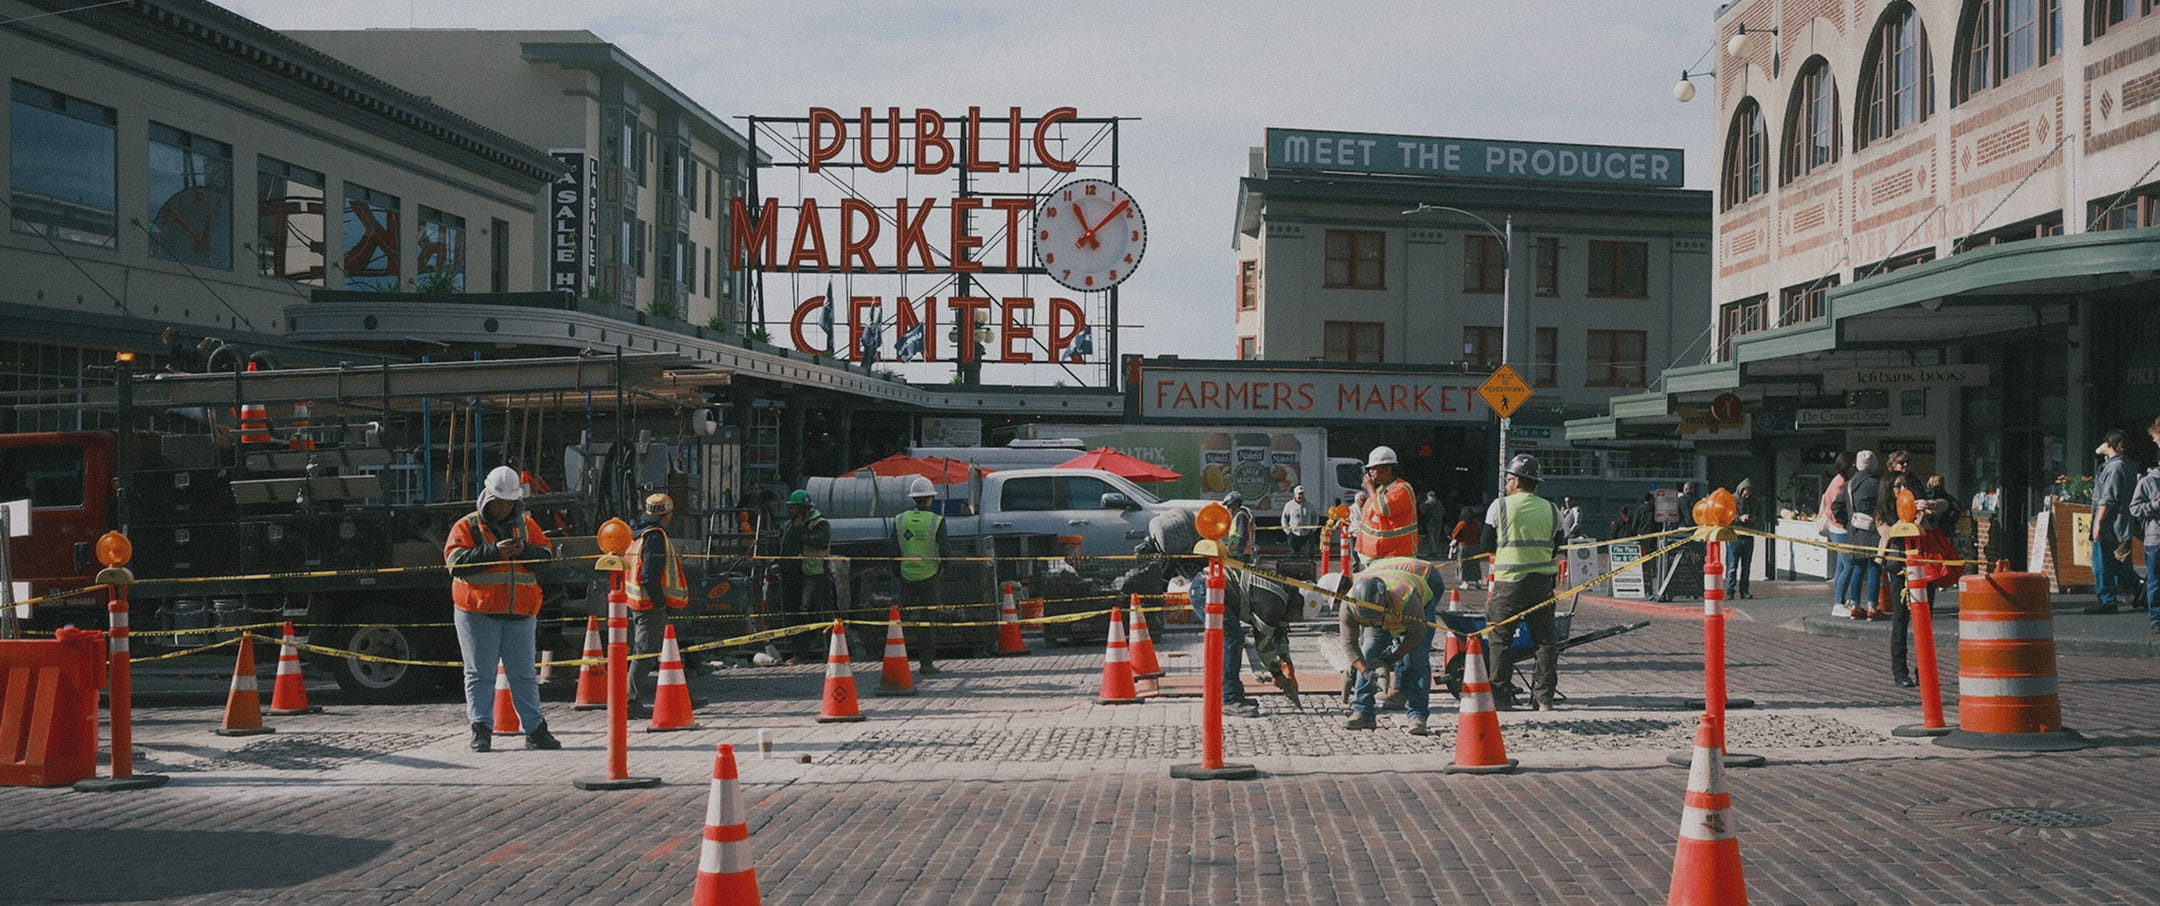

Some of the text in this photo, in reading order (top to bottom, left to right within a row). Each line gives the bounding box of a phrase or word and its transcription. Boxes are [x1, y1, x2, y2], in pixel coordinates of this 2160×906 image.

[808, 106, 1077, 175] PUBLIC
[1284, 135, 1670, 181] MEET THE PRODUCER
[590, 160, 597, 189] LA
[1085, 184, 1096, 195] 12
[1063, 191, 1072, 201] 11
[1111, 191, 1115, 202] 1
[1046, 207, 1057, 218] 10
[1126, 208, 1134, 218] 2
[555, 190, 577, 263] SALLE
[728, 197, 1035, 273] MARKET
[1040, 230, 1049, 240] 9
[1131, 230, 1139, 242] 3
[1046, 253, 1054, 264] 8
[1123, 253, 1133, 264] 4
[1062, 269, 1071, 280] 7
[1109, 269, 1117, 280] 5
[1084, 275, 1093, 286] 6
[790, 296, 1086, 365] CENTER
[1156, 379, 1479, 413] FARMERS MARKET
[748, 632, 775, 640] CAUTION
[784, 626, 810, 635] CAUTION
